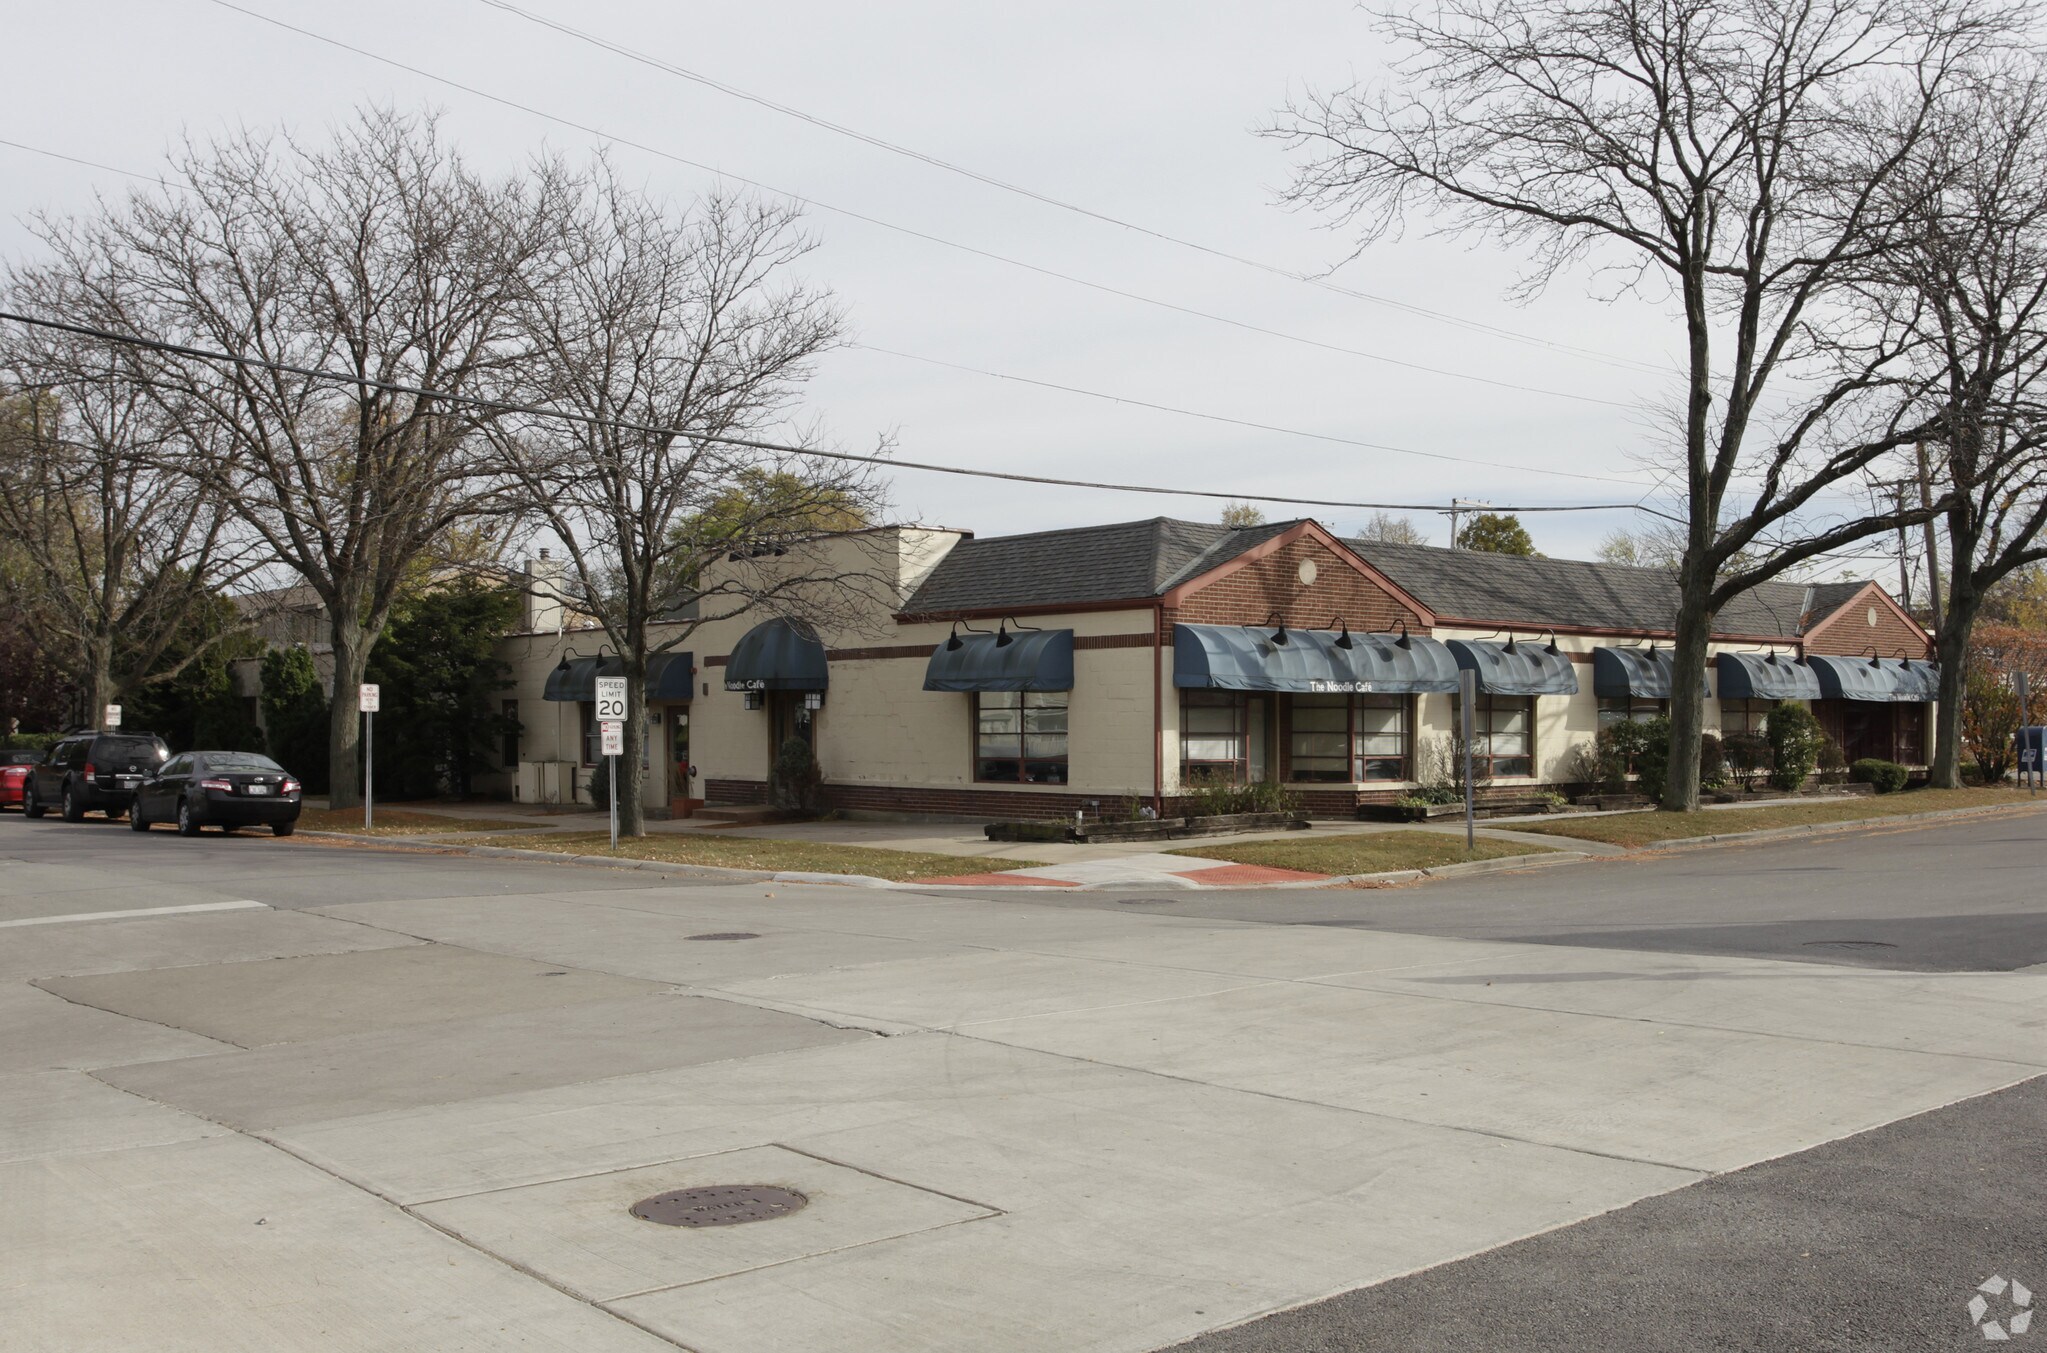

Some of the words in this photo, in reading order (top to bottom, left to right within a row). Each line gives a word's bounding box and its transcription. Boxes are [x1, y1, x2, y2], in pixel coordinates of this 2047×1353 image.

[598, 681, 625, 689] SPEED
[1309, 681, 1324, 692] The
[1326, 681, 1354, 692] Noodle
[1355, 681, 1373, 692] Café
[599, 700, 624, 716] 20
[605, 743, 618, 751] TIME
